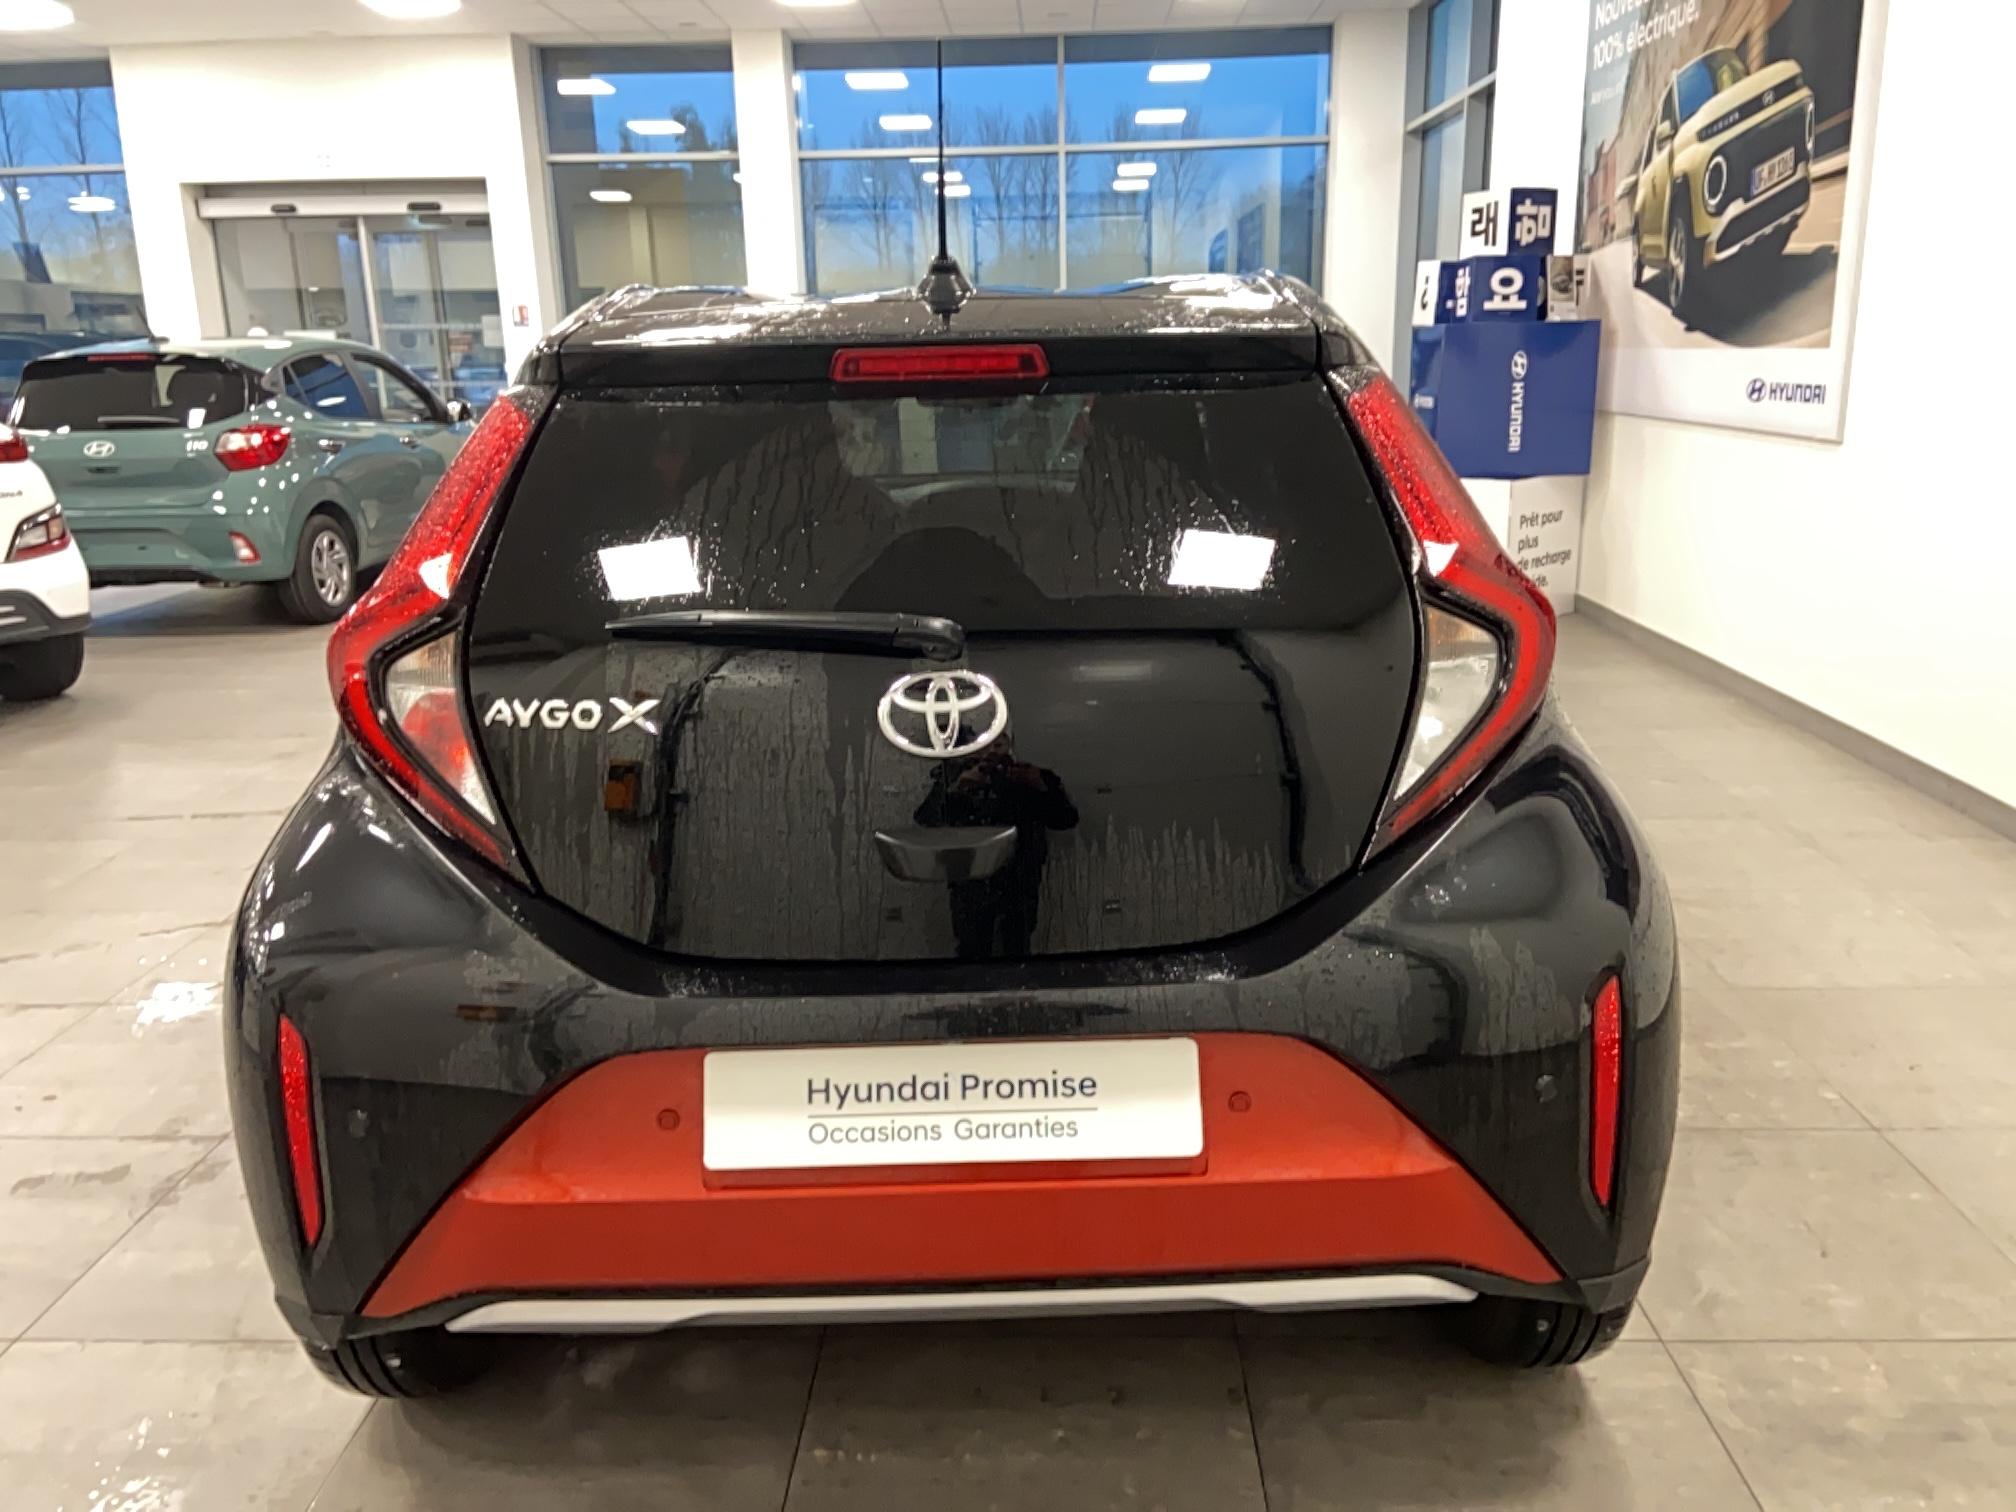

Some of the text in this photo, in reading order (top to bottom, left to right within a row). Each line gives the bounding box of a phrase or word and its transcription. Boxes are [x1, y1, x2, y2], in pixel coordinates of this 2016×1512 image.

[1593, 31, 1624, 70] 100%
[1768, 382, 1827, 404] HYUNDAI
[1508, 381, 1525, 453] HYUNDAI
[1520, 510, 1563, 529] Prêt pour
[1518, 535, 1539, 554] plus
[1531, 549, 1571, 568] recharge
[484, 697, 661, 736] AYGO X
[807, 1070, 1097, 1111] Hyundai Promise
[808, 1115, 1079, 1144] Occasions Garanties
